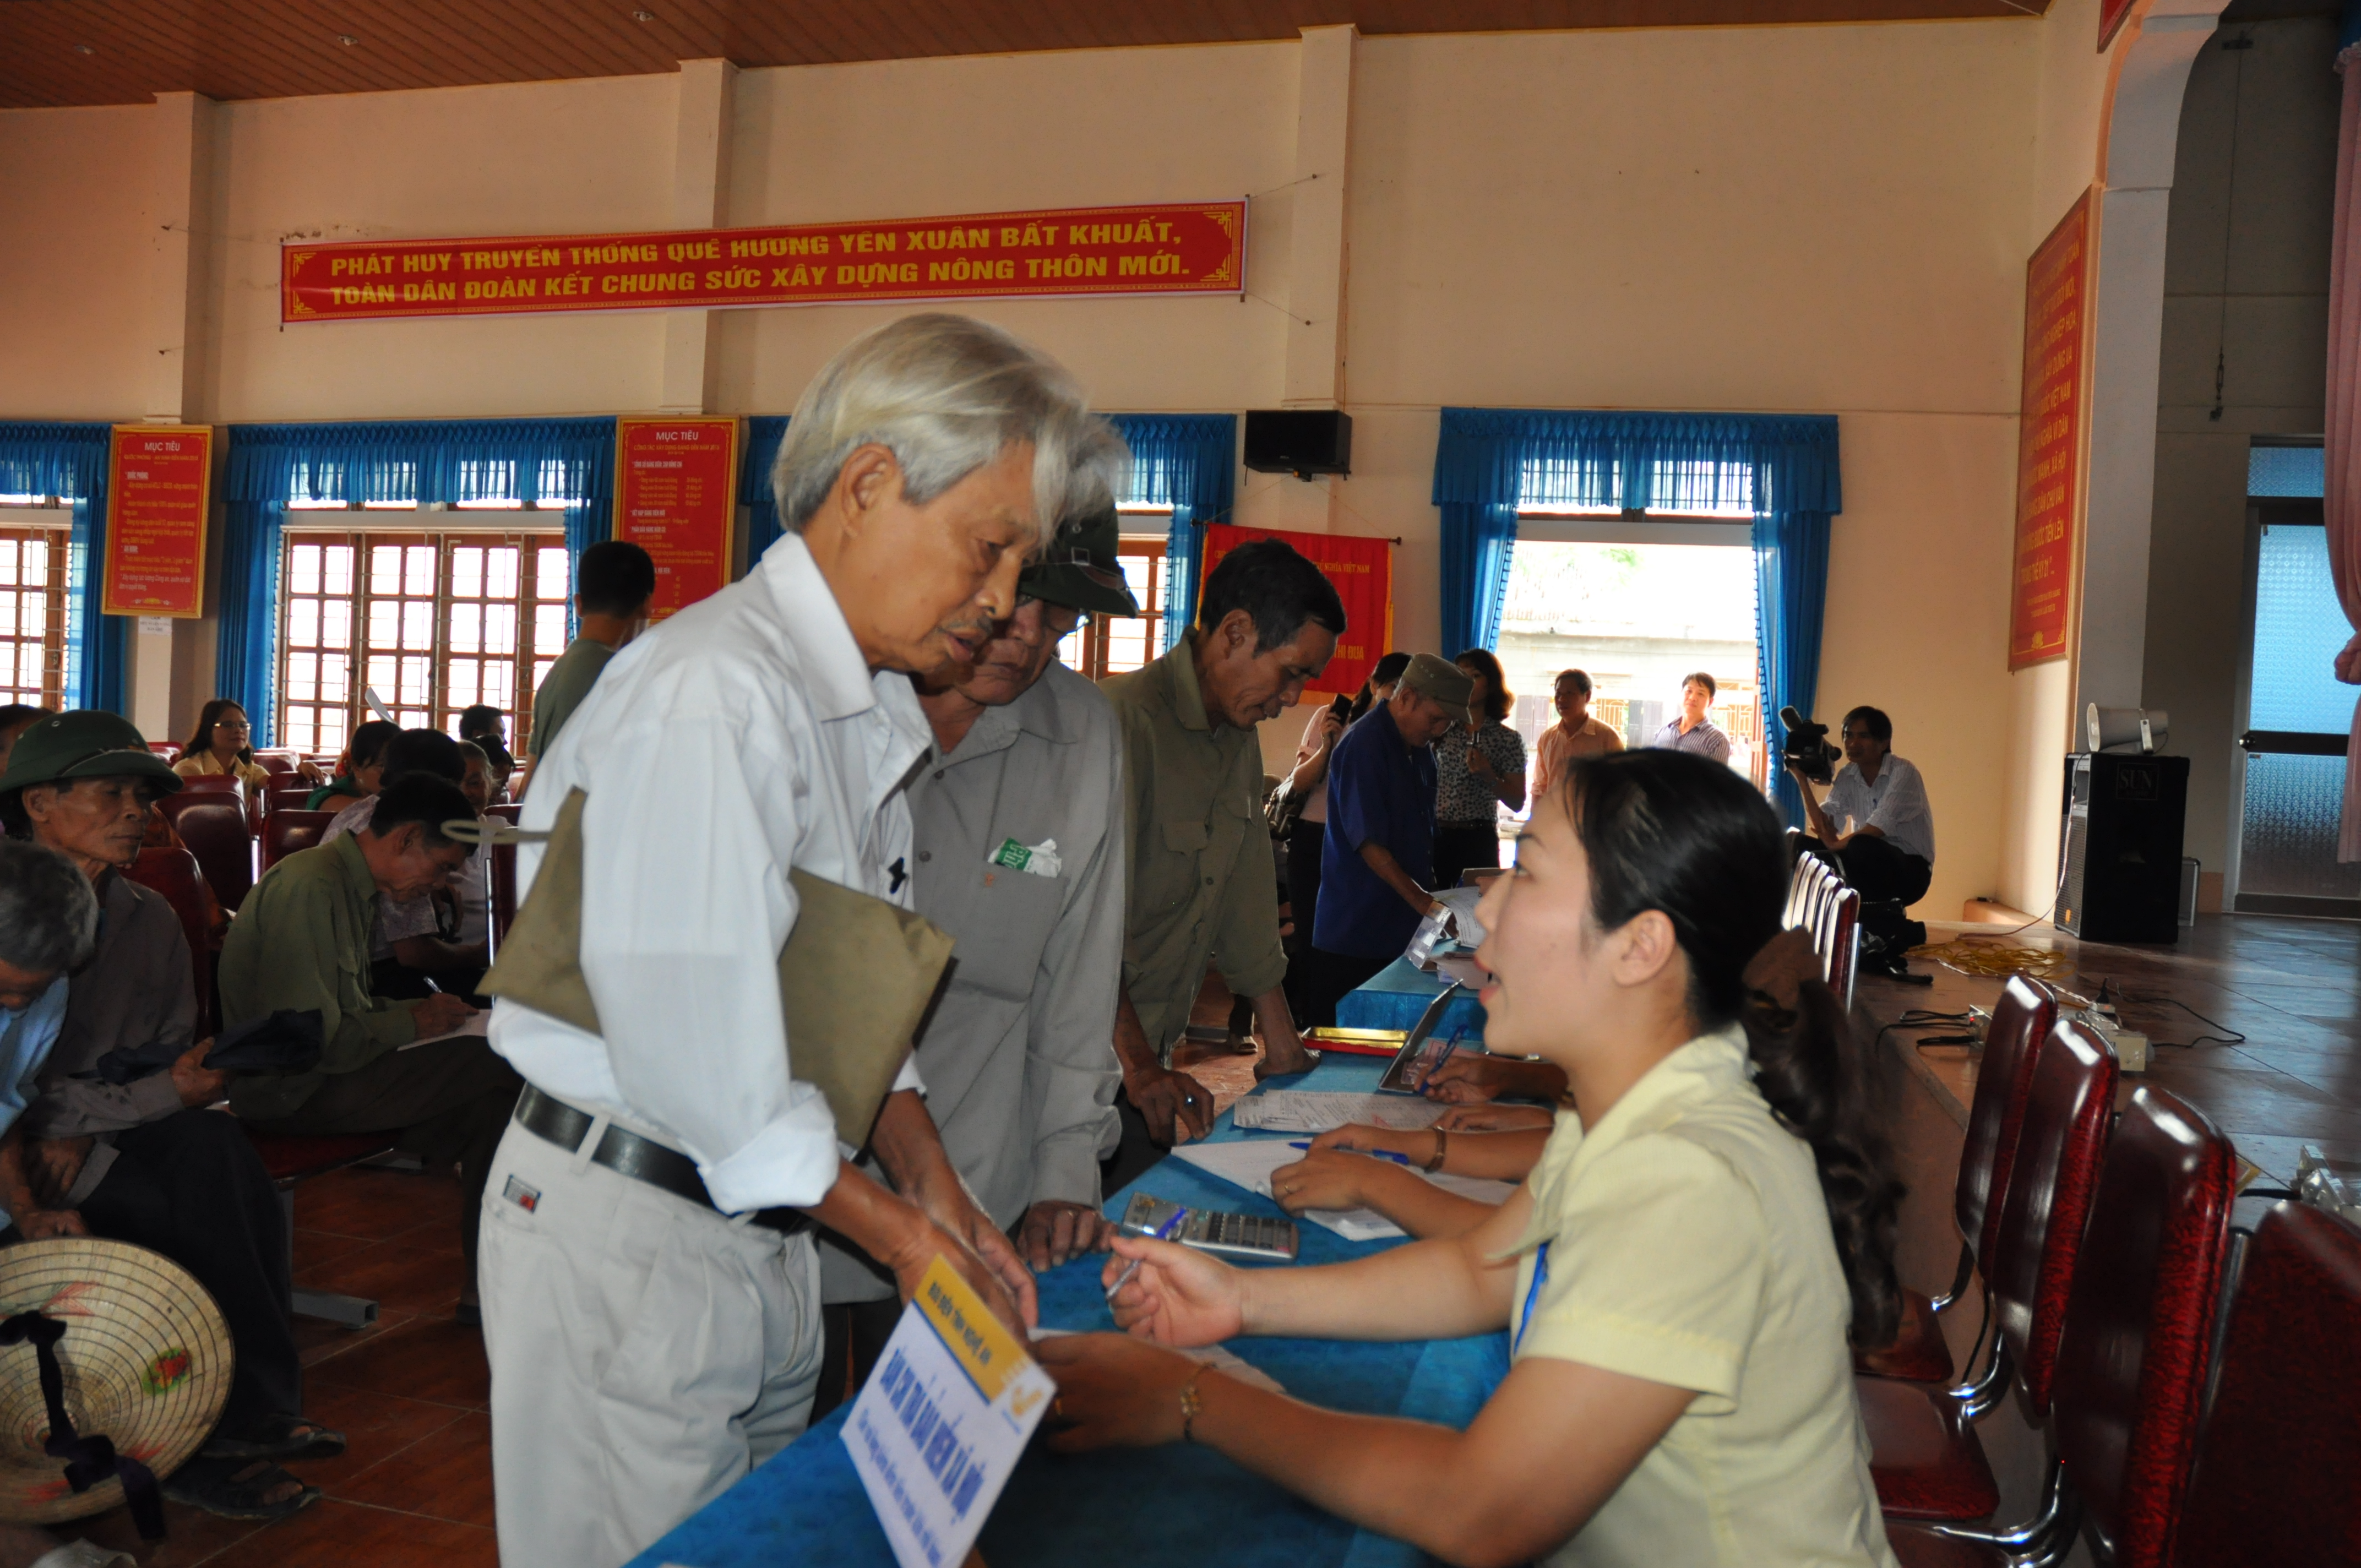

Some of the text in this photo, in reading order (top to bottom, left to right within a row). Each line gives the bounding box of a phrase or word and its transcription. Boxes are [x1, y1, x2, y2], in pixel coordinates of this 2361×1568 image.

[331, 215, 1181, 276] PHÁT HUY TRUYỀN THỐNG QUÊ HƯƠNG YÊN XUÂN BẤT KHUẤT,
[331, 250, 1189, 305] TOÀN DÂN ĐOÀN KẾT CHUNG SỨC XÂY DỰNG NÔNG THÔN MỚI.
[2060, 379, 2071, 404] NAM
[145, 440, 180, 453] MỤC TIÊU
[656, 430, 699, 442] MỤC TIÊU
[2054, 516, 2064, 540] LÊN
[1357, 564, 1370, 573] NAM
[1348, 645, 1364, 660] ĐUA
[2119, 769, 2152, 790] SUN
